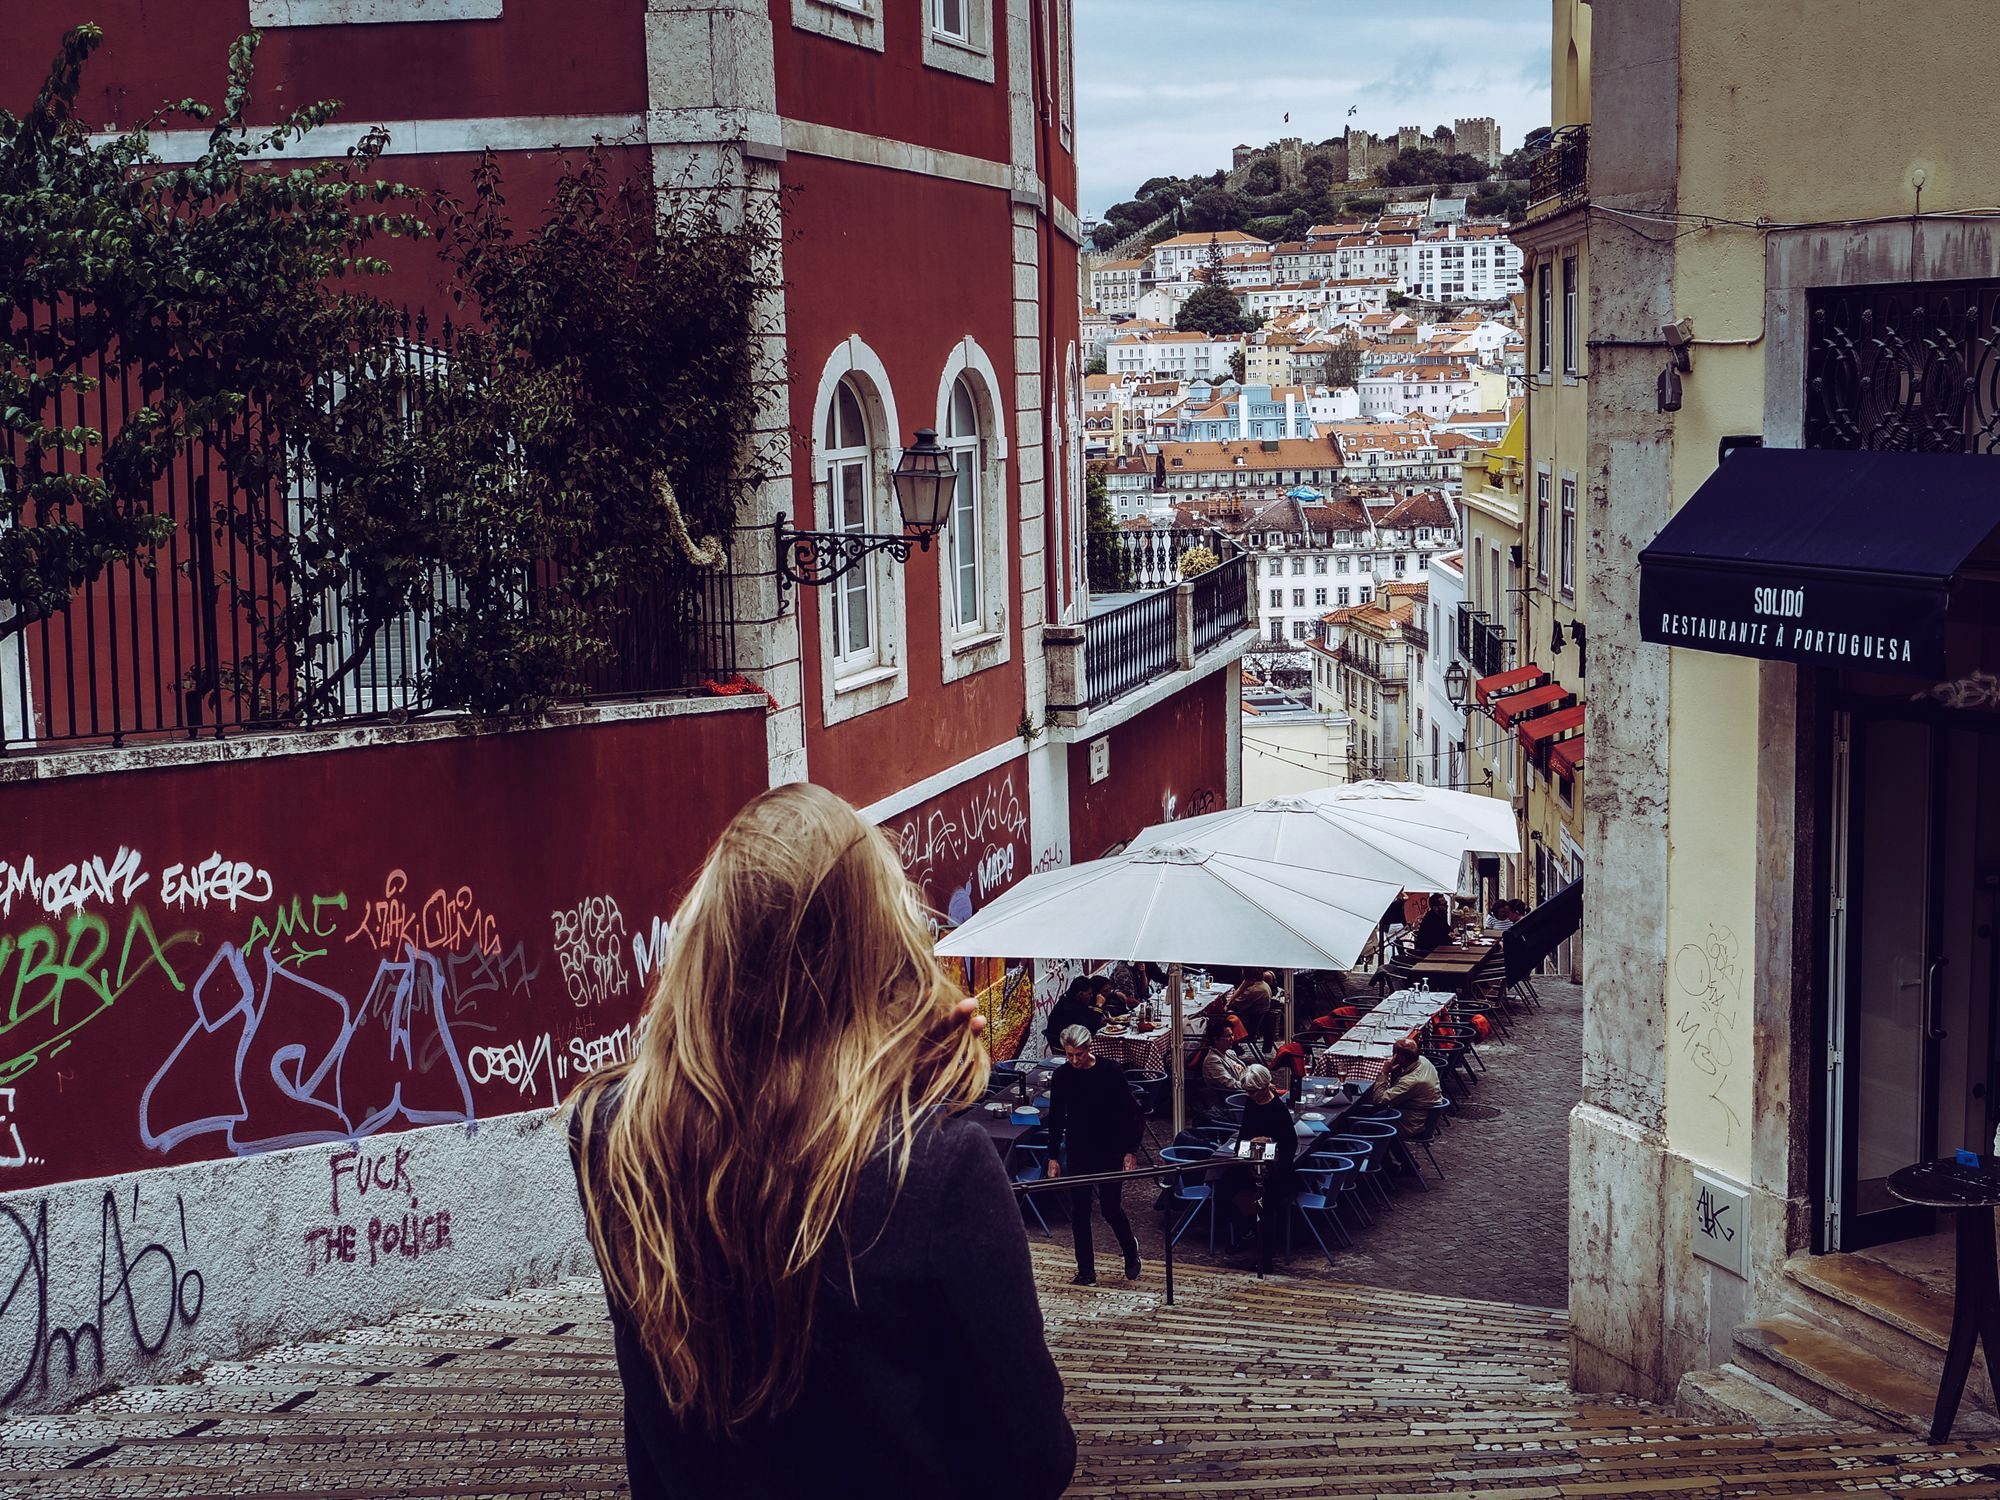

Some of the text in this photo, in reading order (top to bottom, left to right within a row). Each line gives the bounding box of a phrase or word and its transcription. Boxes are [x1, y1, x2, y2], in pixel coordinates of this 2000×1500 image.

[1754, 586, 1804, 618] SOLIDÓ
[1661, 613, 1912, 662] RESTAURANTE À PORTUGUESA
[330, 1146, 413, 1216] FUCK
[304, 1197, 452, 1276] THE POLICE
